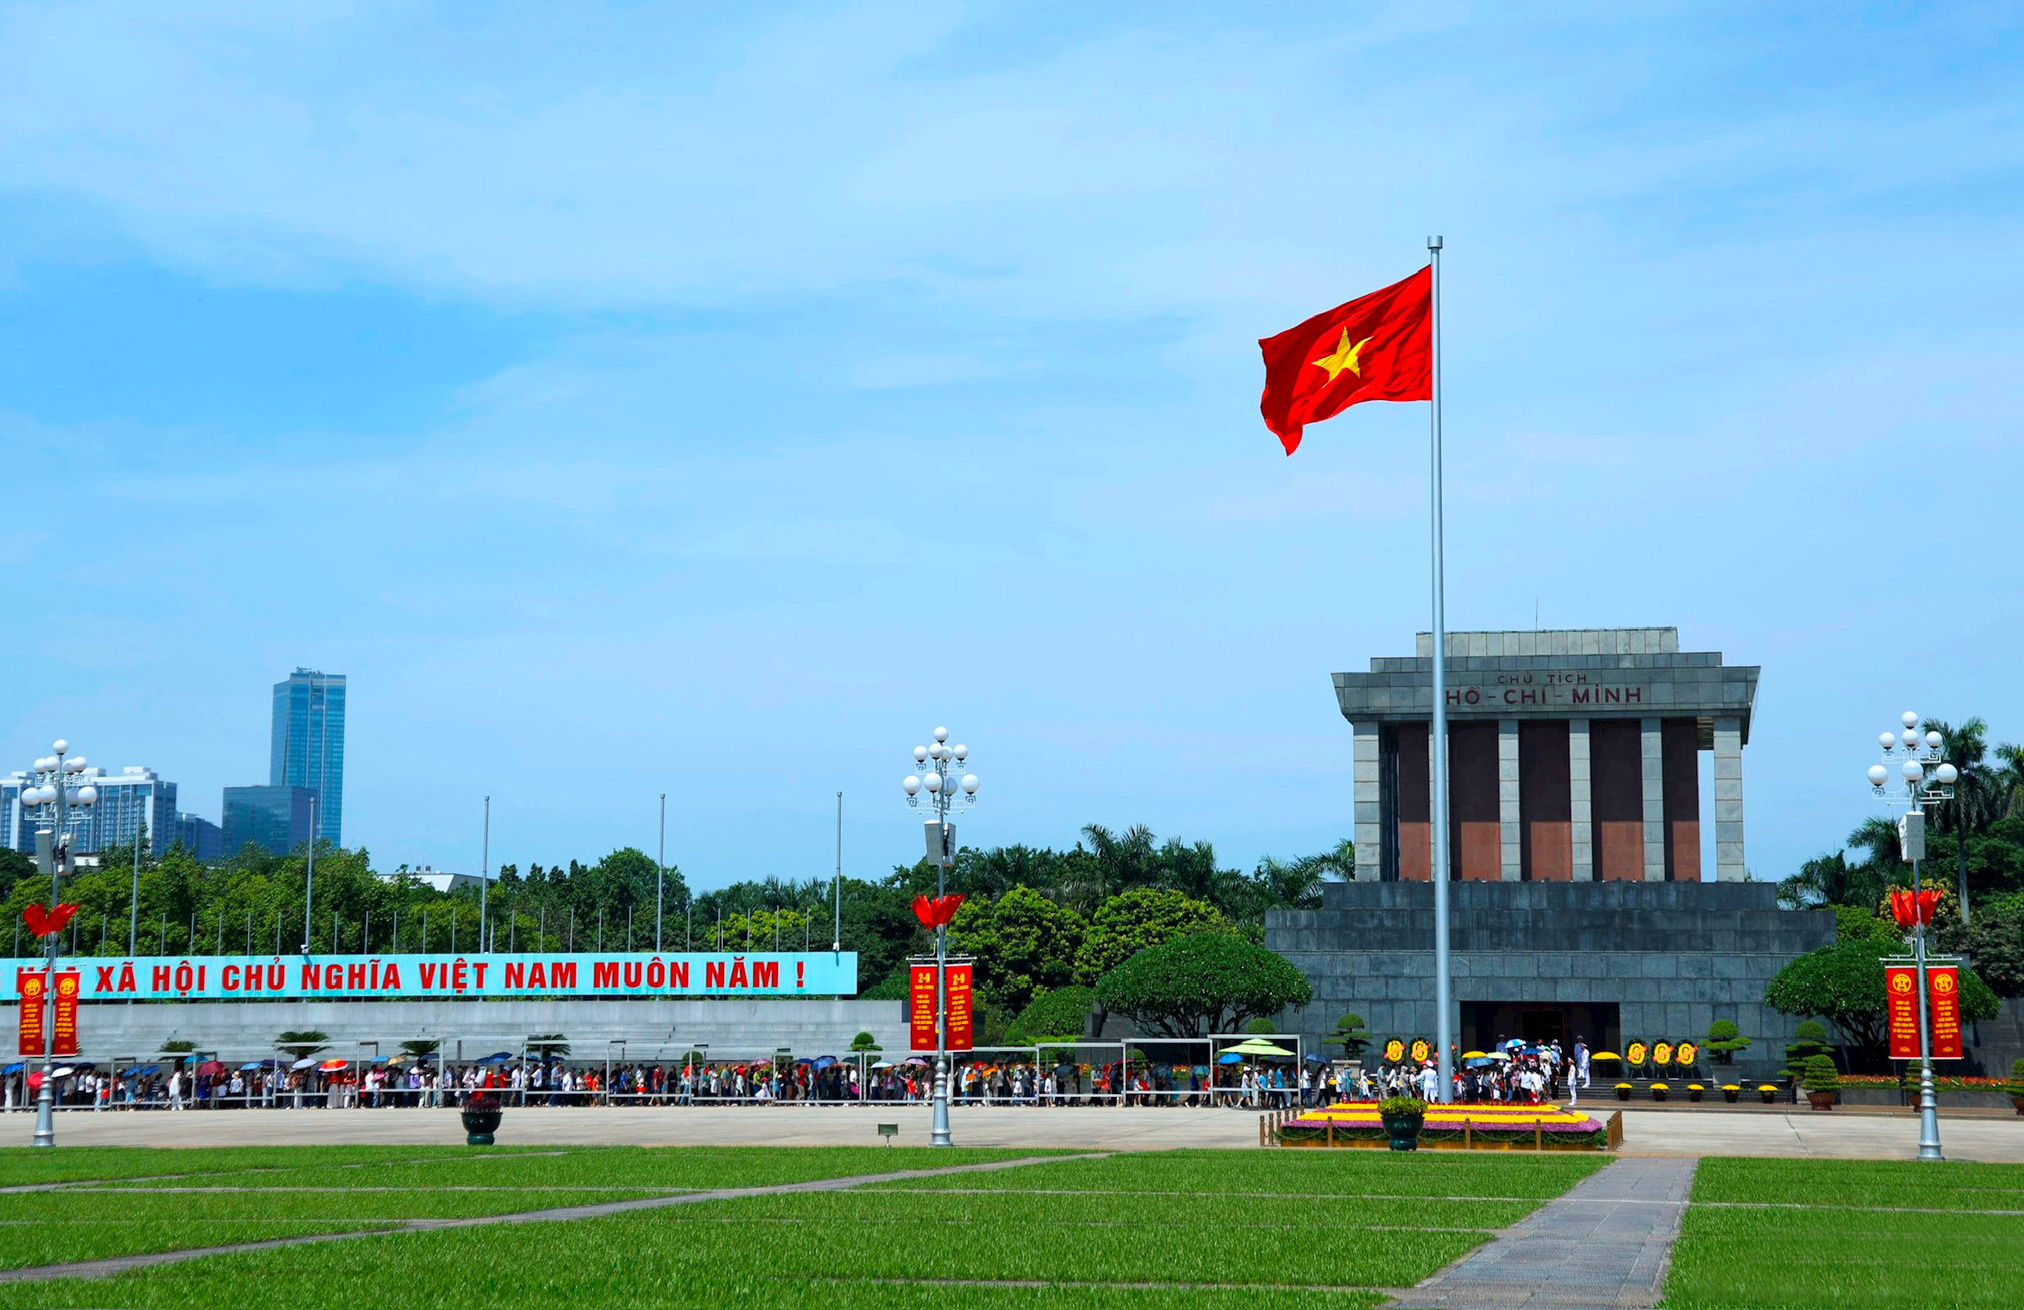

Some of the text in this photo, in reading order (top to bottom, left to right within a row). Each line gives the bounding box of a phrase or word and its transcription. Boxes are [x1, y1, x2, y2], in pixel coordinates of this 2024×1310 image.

[1496, 671, 1533, 685] CHỦ
[95, 961, 138, 992] XÃ
[152, 959, 207, 996] HỘI
[222, 957, 287, 992] CHỦ
[301, 959, 401, 991] NGHĨA
[420, 957, 489, 994] VIỆT
[505, 962, 578, 989] NAM
[593, 956, 690, 989] MUÔN
[705, 956, 780, 989] NĂM
